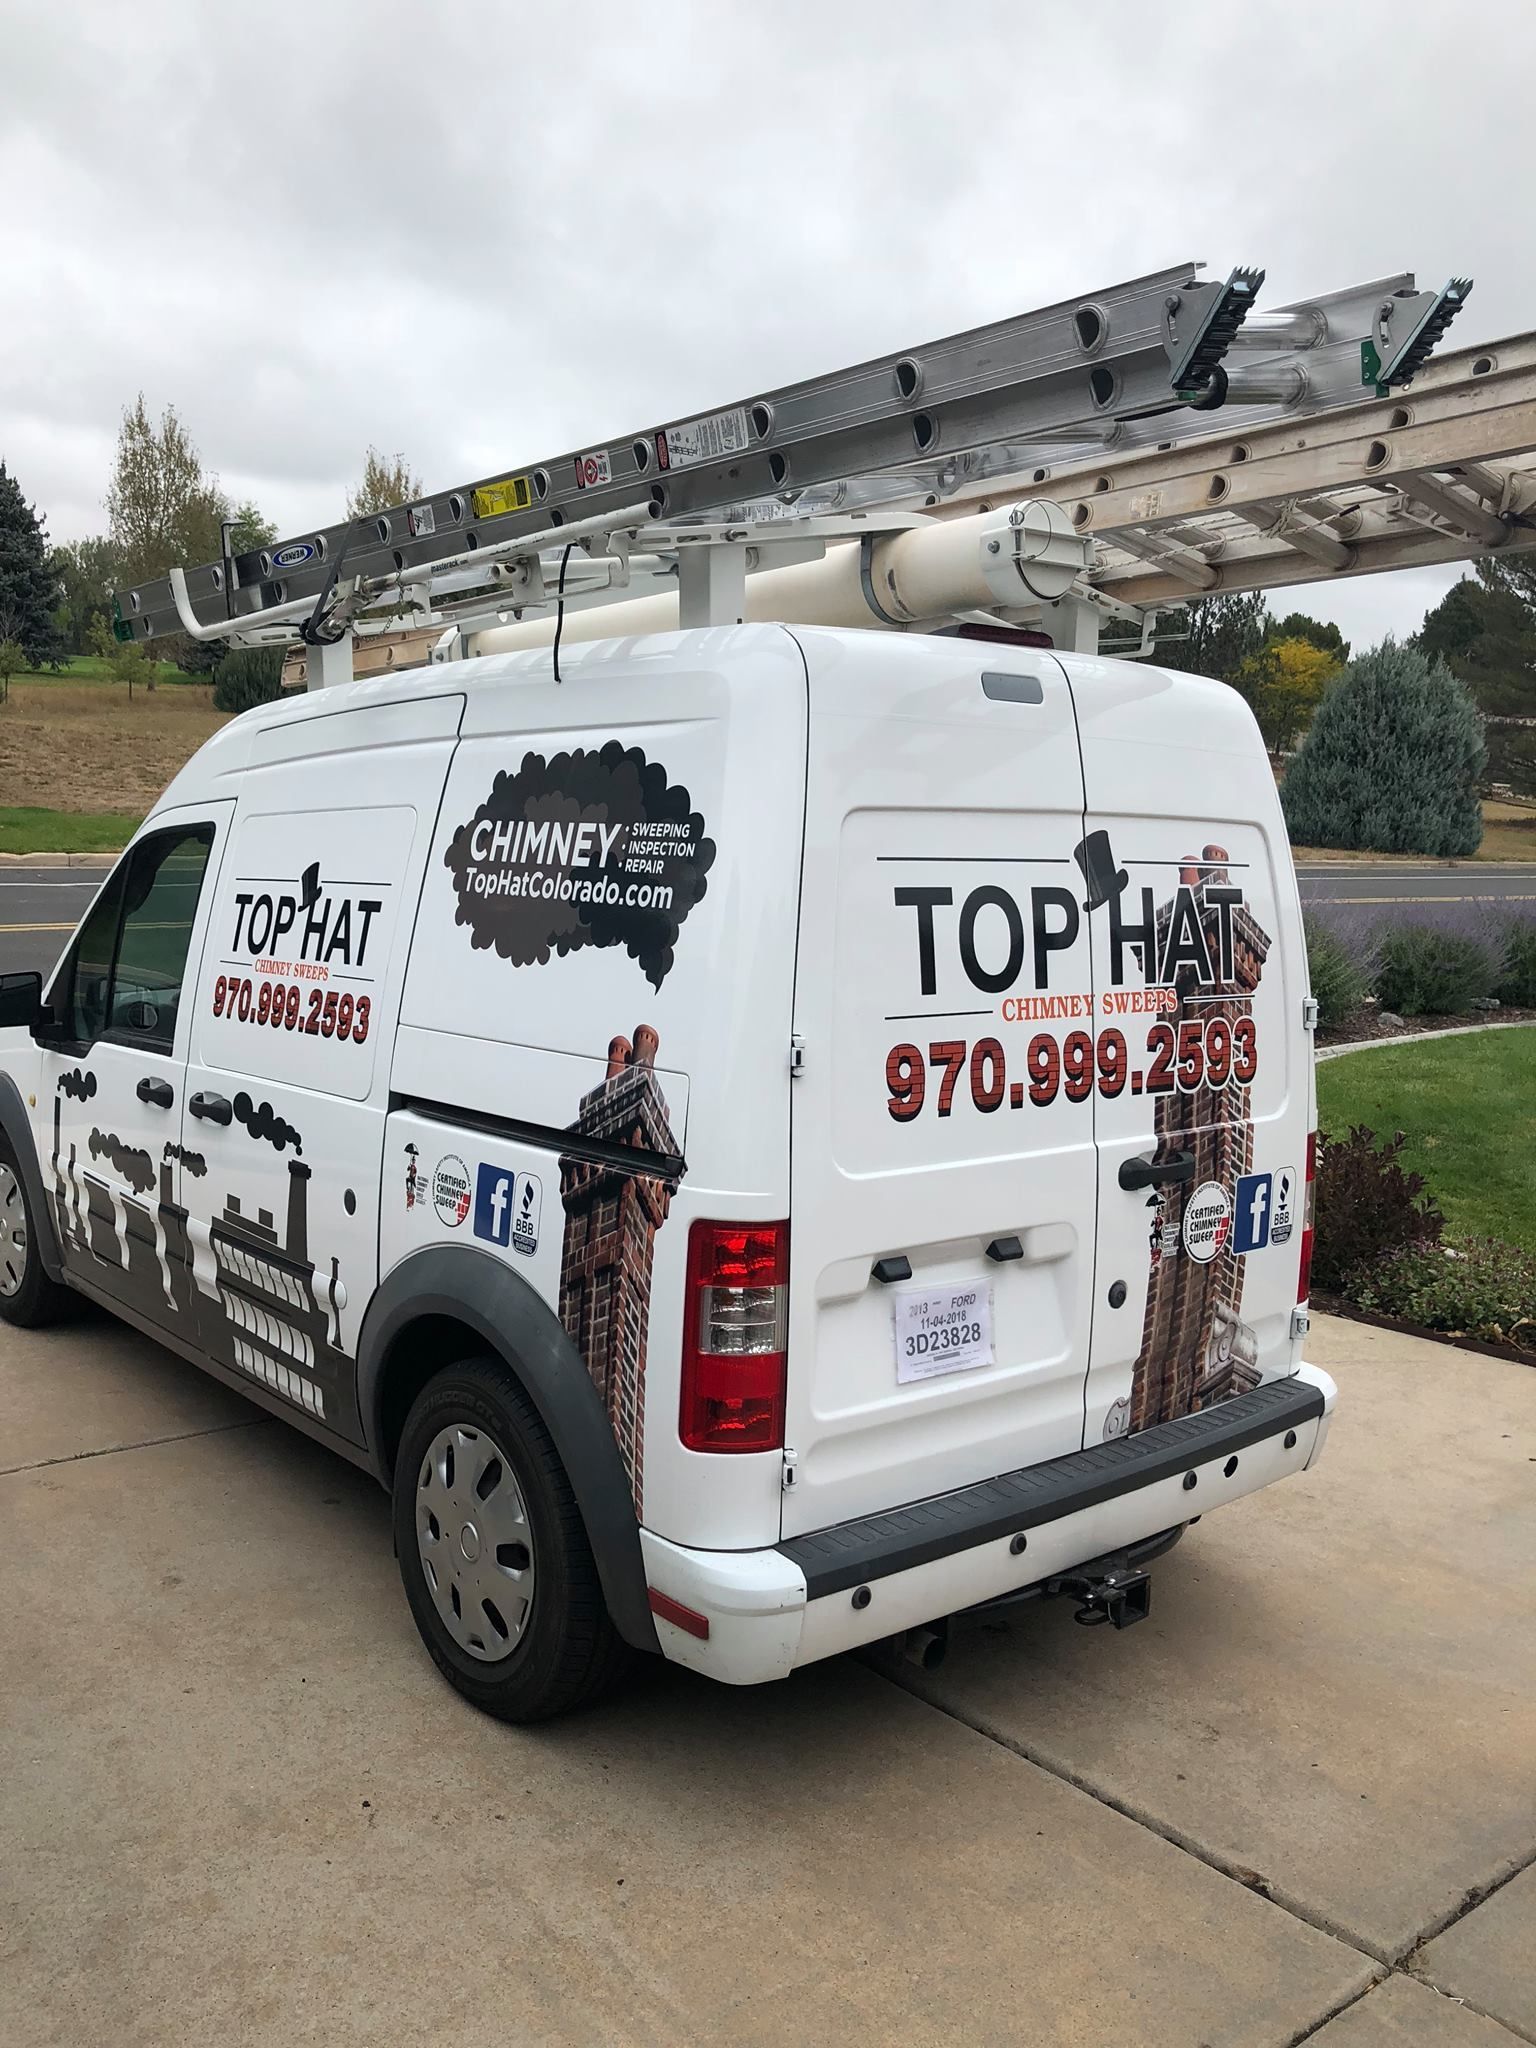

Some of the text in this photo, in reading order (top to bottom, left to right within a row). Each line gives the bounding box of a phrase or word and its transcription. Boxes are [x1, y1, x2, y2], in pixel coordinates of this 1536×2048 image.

[632, 823, 690, 838] SWEEPING
[470, 819, 622, 868] CHIMNEY
[628, 841, 695, 857] INSPECTION
[625, 859, 664, 874] REPAIR
[465, 867, 673, 909] TopHatColorado.com
[232, 894, 382, 966] TOP HAT
[894, 884, 1243, 996] TOP HAT
[255, 959, 329, 981] CHIMNEY SWEEPS
[213, 975, 371, 1044] 970.999.2593
[1002, 988, 1178, 1022] CHIMNEY SWEEPS
[885, 1018, 1258, 1123] 970.999.2593
[437, 1172, 467, 1190] CERTIFIED
[436, 1184, 463, 1200] CHIMNEY
[435, 1195, 456, 1210] SWEEP
[1190, 1204, 1225, 1220] CERTIFIED
[1274, 1212, 1290, 1226] BBB
[516, 1219, 534, 1236] BBB
[1190, 1216, 1222, 1232] CHIMNEY
[1189, 1231, 1214, 1245] SWEEP
[951, 1293, 976, 1309] FORD
[921, 1310, 967, 1330] 11-04-2018
[906, 1322, 981, 1357] 3D23828
